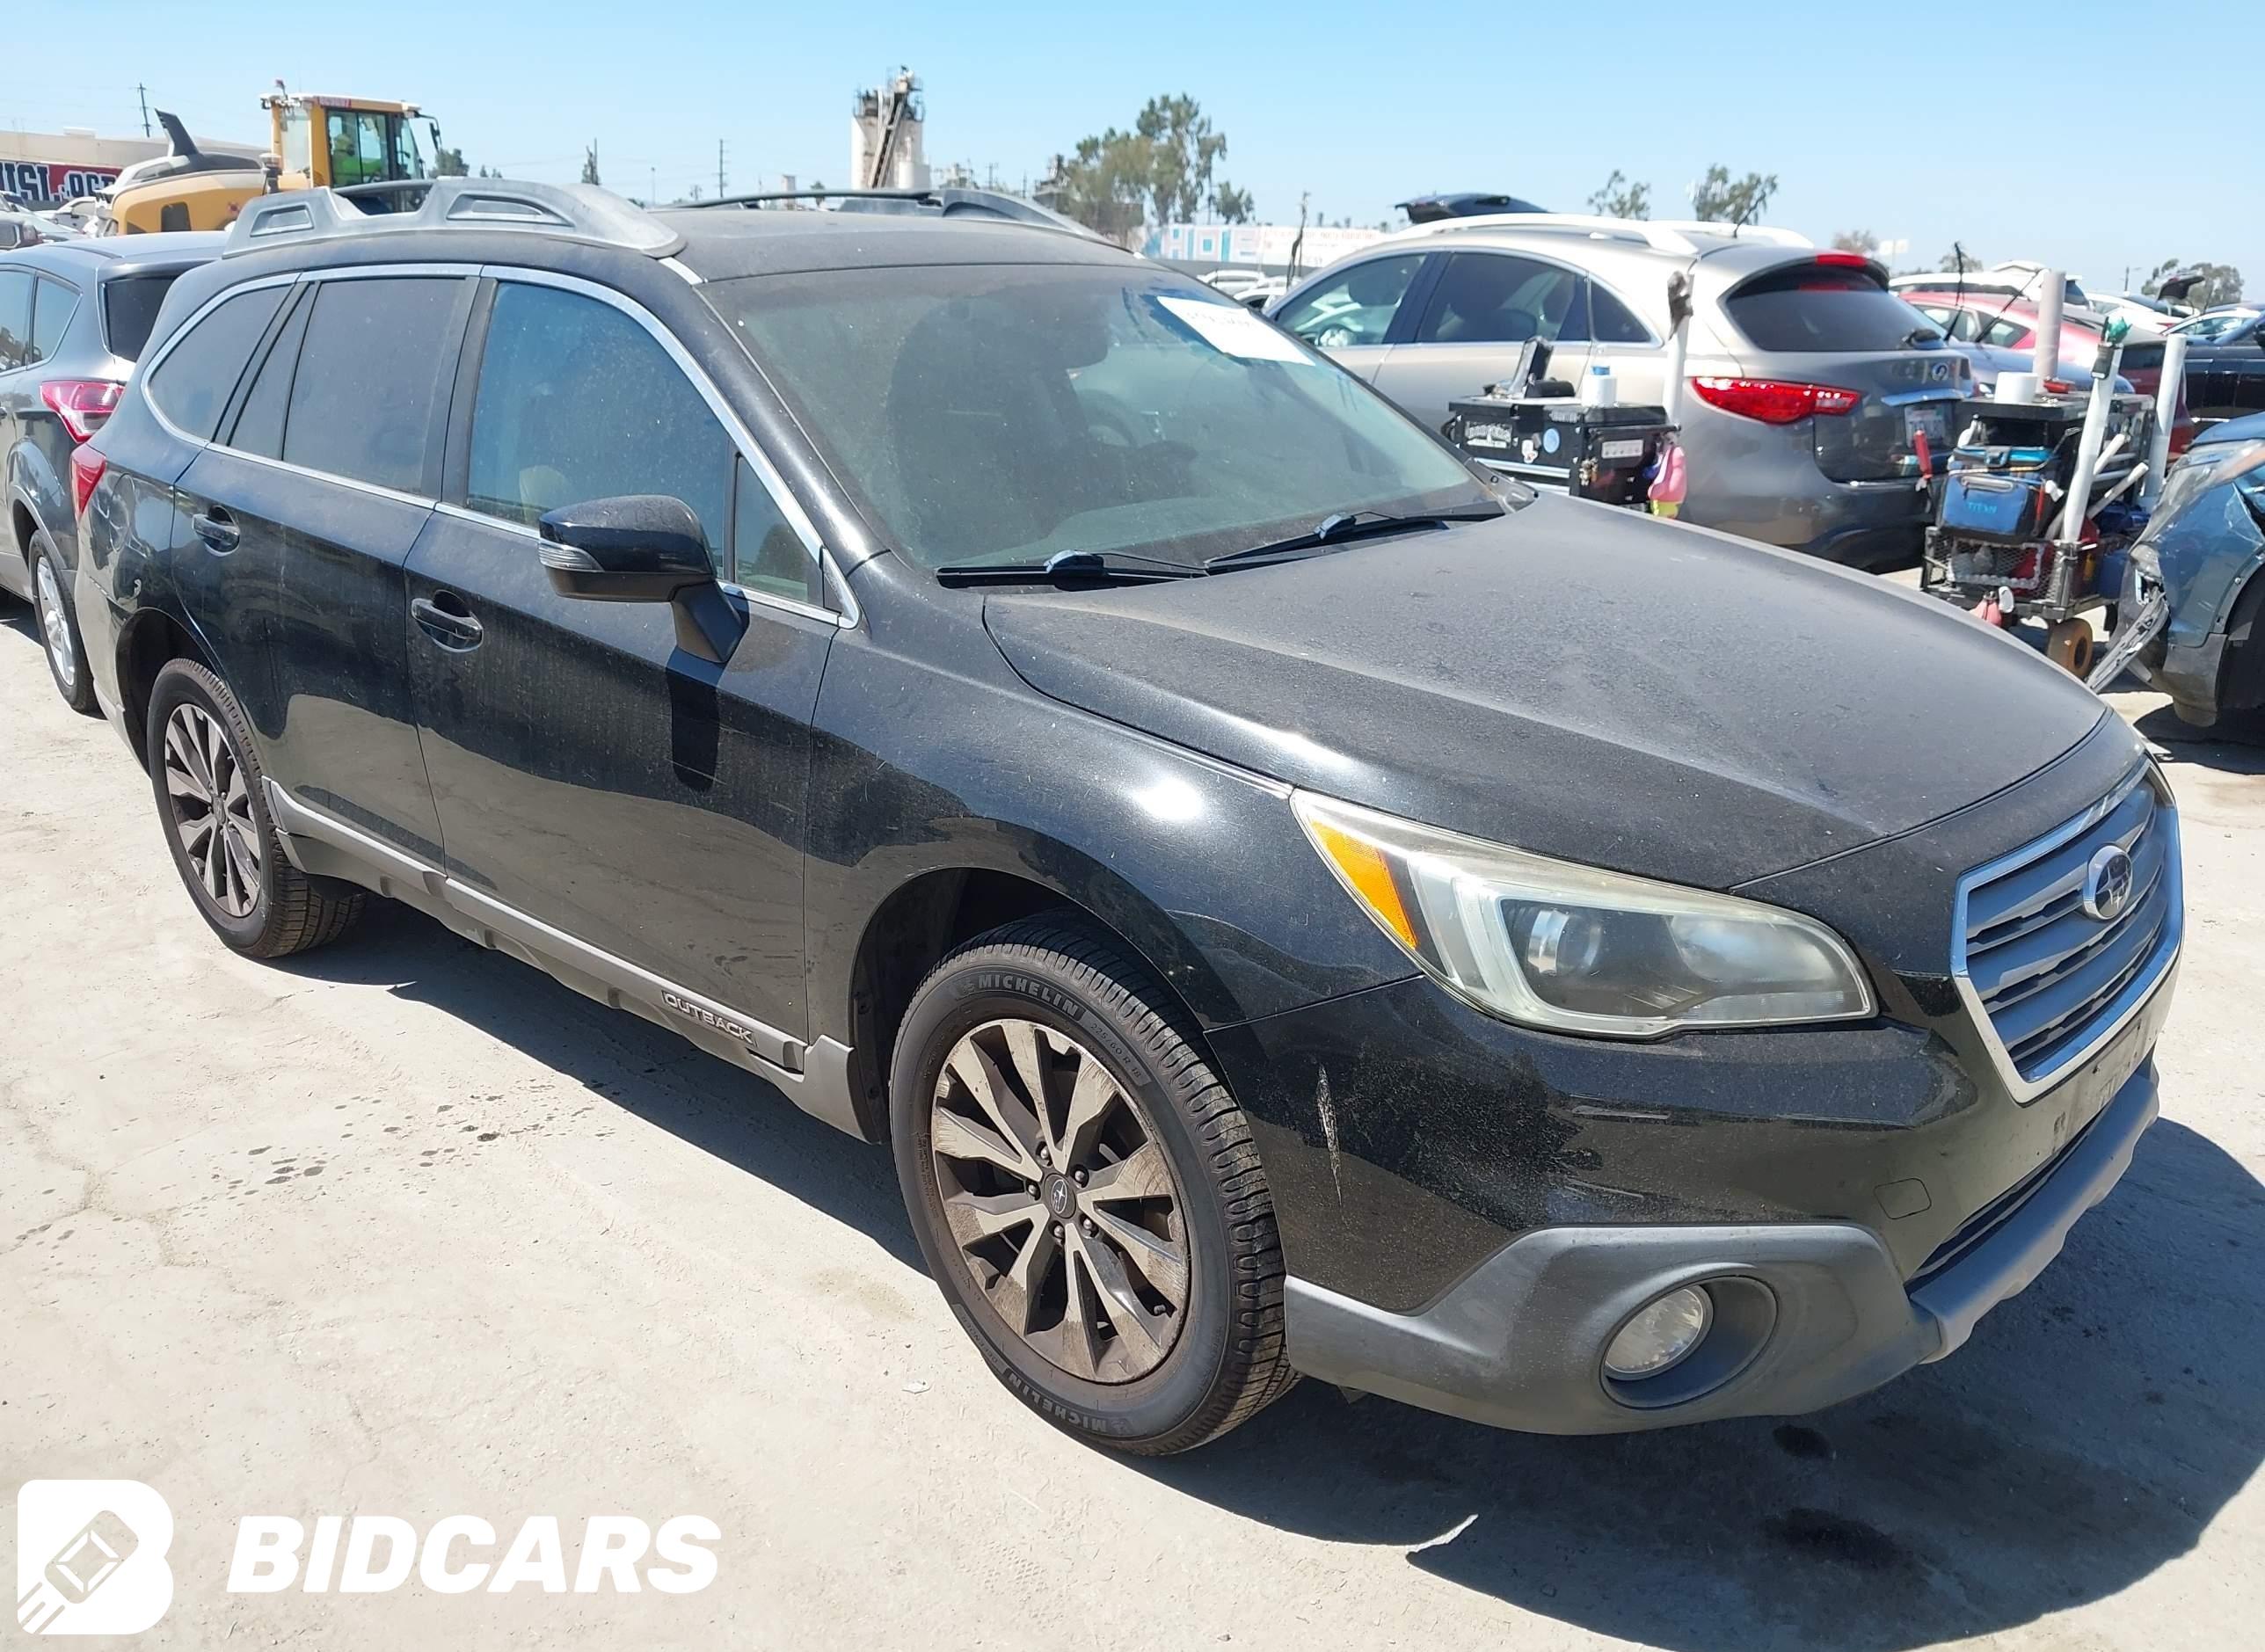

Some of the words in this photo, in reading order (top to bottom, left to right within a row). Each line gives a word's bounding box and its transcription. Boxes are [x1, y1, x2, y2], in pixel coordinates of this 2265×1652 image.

[664, 993, 754, 1044] OUTBACK
[978, 974, 1079, 1017] MICHELIN
[1090, 1022, 1123, 1055] 225/60
[1009, 1370, 1107, 1431] MICHELIN
